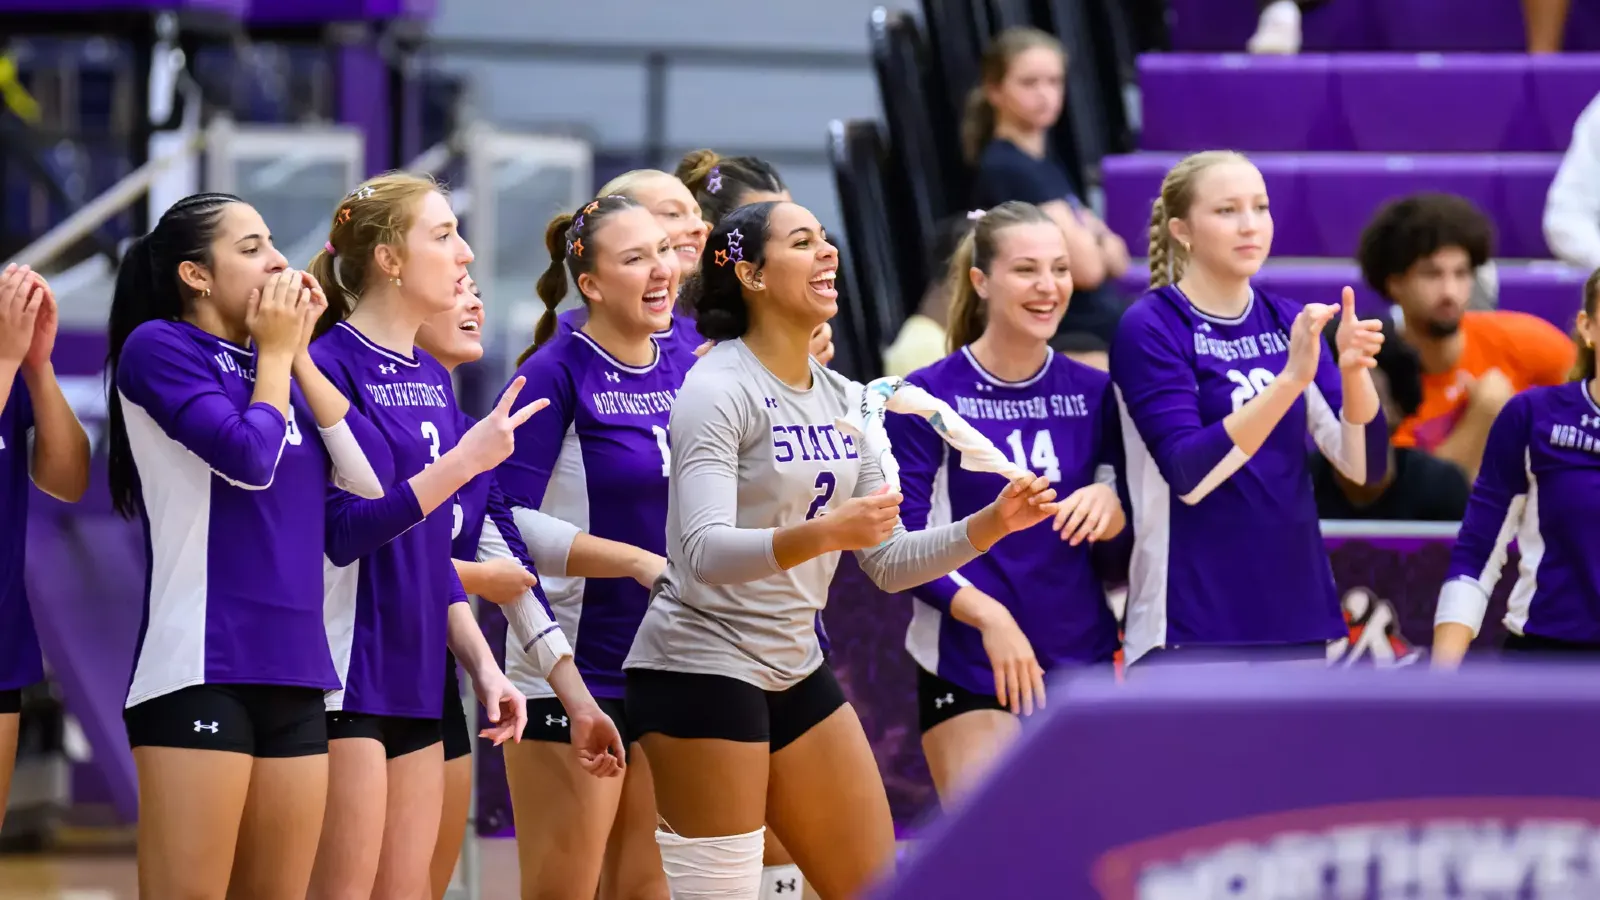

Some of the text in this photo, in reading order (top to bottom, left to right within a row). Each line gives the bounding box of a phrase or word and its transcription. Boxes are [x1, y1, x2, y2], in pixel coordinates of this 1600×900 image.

[592, 390, 675, 415] NORTHWESTERN
[954, 394, 1088, 420] NORTHWESTERN STATE
[421, 421, 441, 470] 3
[772, 424, 859, 463] STATE
[1006, 429, 1061, 483] 14
[805, 471, 836, 522] 2
